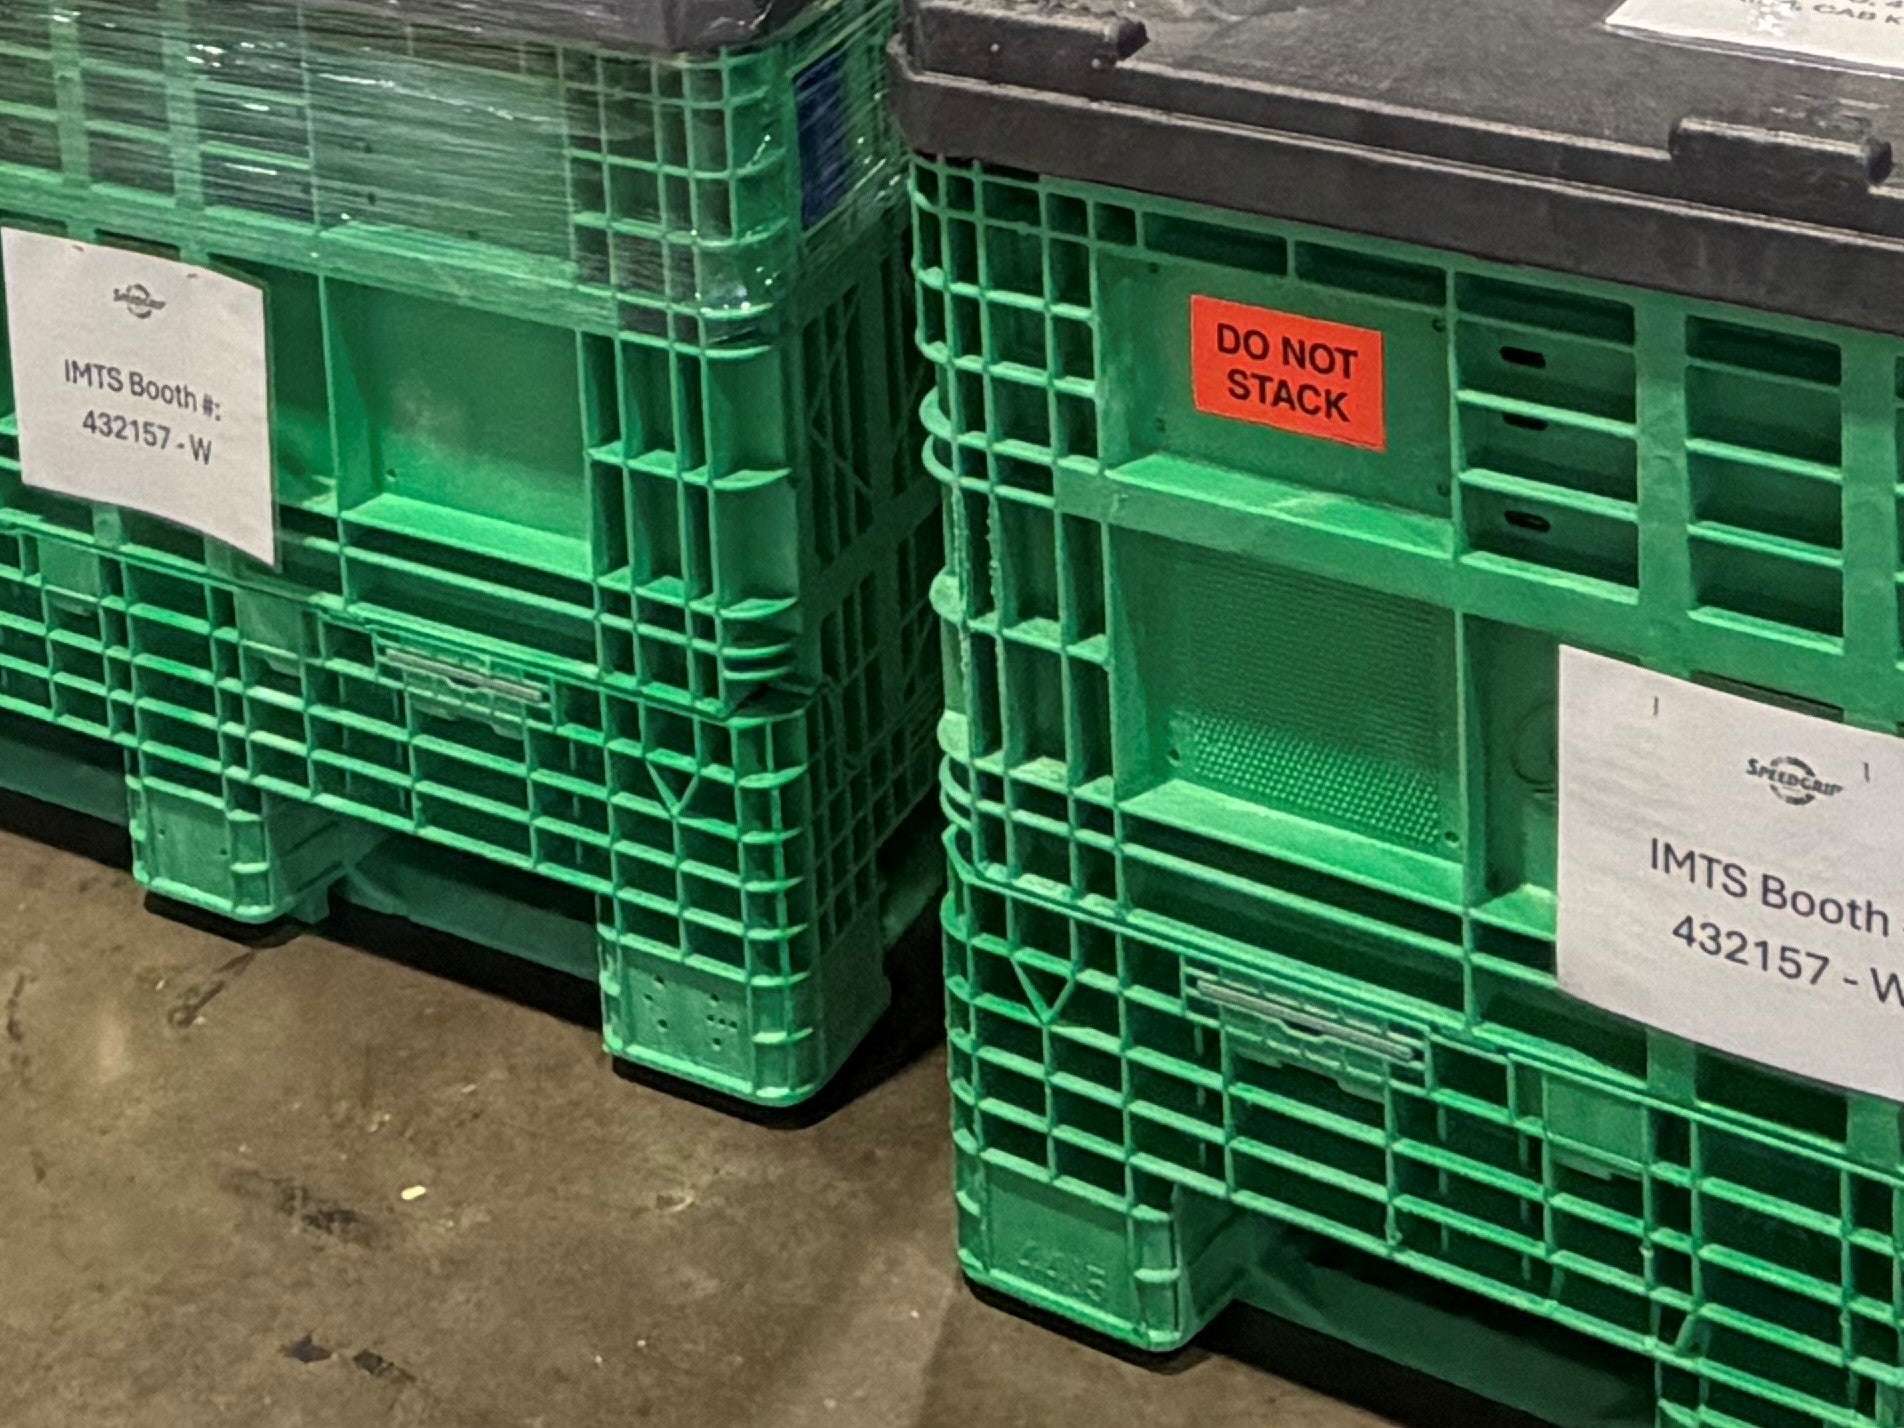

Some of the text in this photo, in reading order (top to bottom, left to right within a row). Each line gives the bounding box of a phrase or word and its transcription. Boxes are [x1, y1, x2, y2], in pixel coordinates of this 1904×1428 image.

[1812, 3, 1878, 21] CAB
[1217, 323, 1358, 379] DO NOT
[64, 359, 222, 421] IMTS Booth #:
[1227, 369, 1349, 422] STACK
[81, 408, 172, 450] 432157
[189, 435, 213, 465] W
[1649, 838, 1748, 898] IMTS
[1761, 873, 1889, 938] Booth
[1672, 915, 1830, 986] 432157
